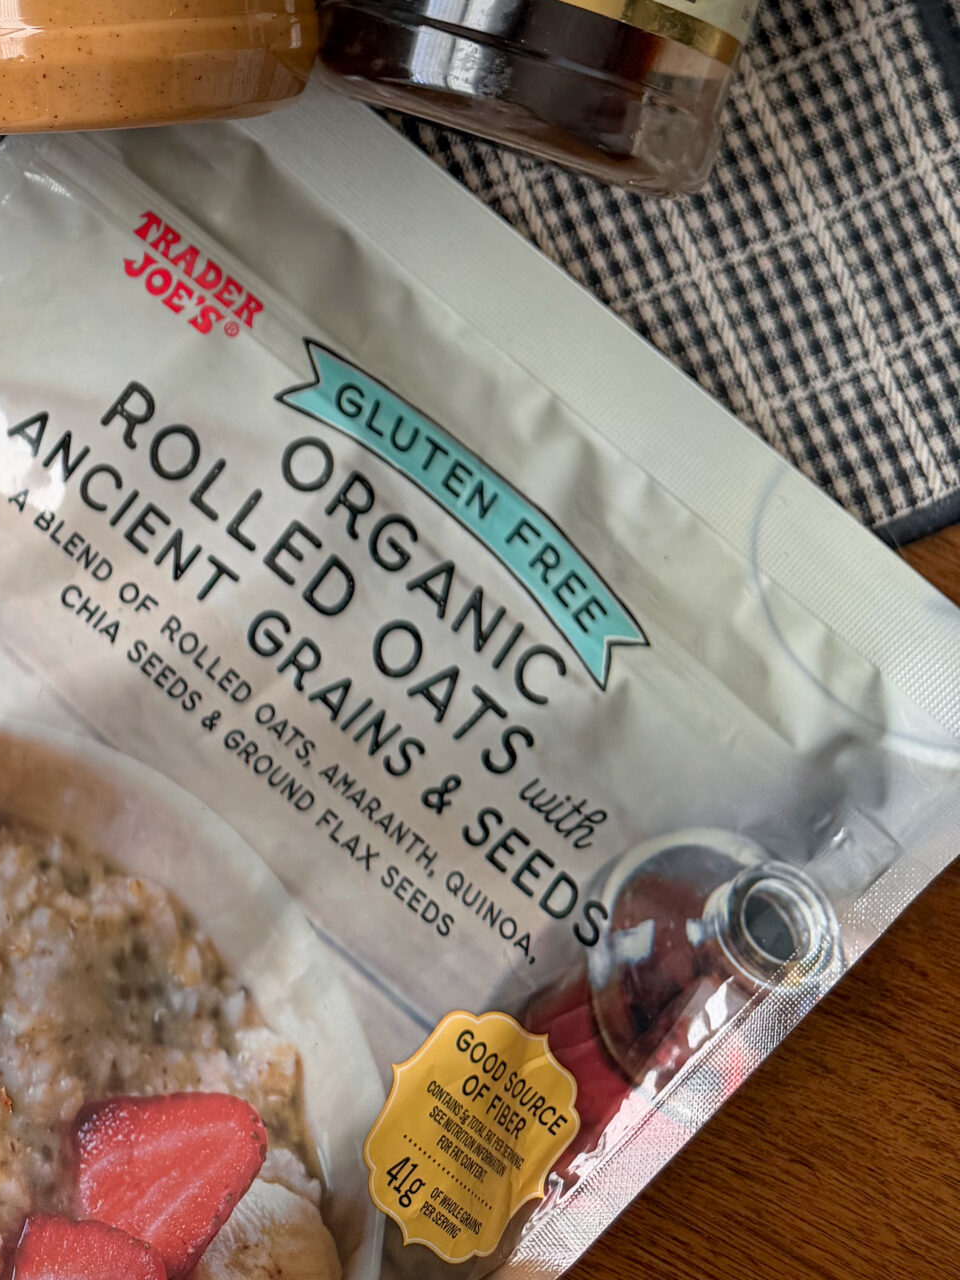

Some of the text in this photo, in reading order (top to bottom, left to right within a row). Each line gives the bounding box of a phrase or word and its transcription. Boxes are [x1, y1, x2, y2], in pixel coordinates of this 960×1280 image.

[133, 210, 264, 329] TRADER
[334, 383, 608, 634] GLUTEN FREE
[100, 380, 608, 849] ROLLED OATS with
[281, 436, 567, 705] ORGANIC
[7, 411, 609, 948] ANCIENT GRAINS & SEEDS
[8, 489, 536, 965] A BLEND OF ROLLED OATS, AMARANTH, QUINOA,
[60, 584, 455, 938] CHIA SEEDS & GROUND FLAX SEEDS
[427, 1080, 464, 1117] CONTAINS
[467, 1115, 487, 1138] TOTAL
[484, 1129, 496, 1145] FAT
[491, 1136, 505, 1152] PER
[456, 1029, 568, 1136] GOOD SOURCE
[462, 1074, 526, 1140] OF FIBER
[386, 1156, 483, 1235] 41g OF WHOLE GRAINS
[429, 1105, 508, 1177] SEE NUTRITION INFORMATION
[436, 1134, 453, 1154] FOR
[449, 1145, 465, 1162] FAT
[419, 1201, 461, 1239] PER SERVING
